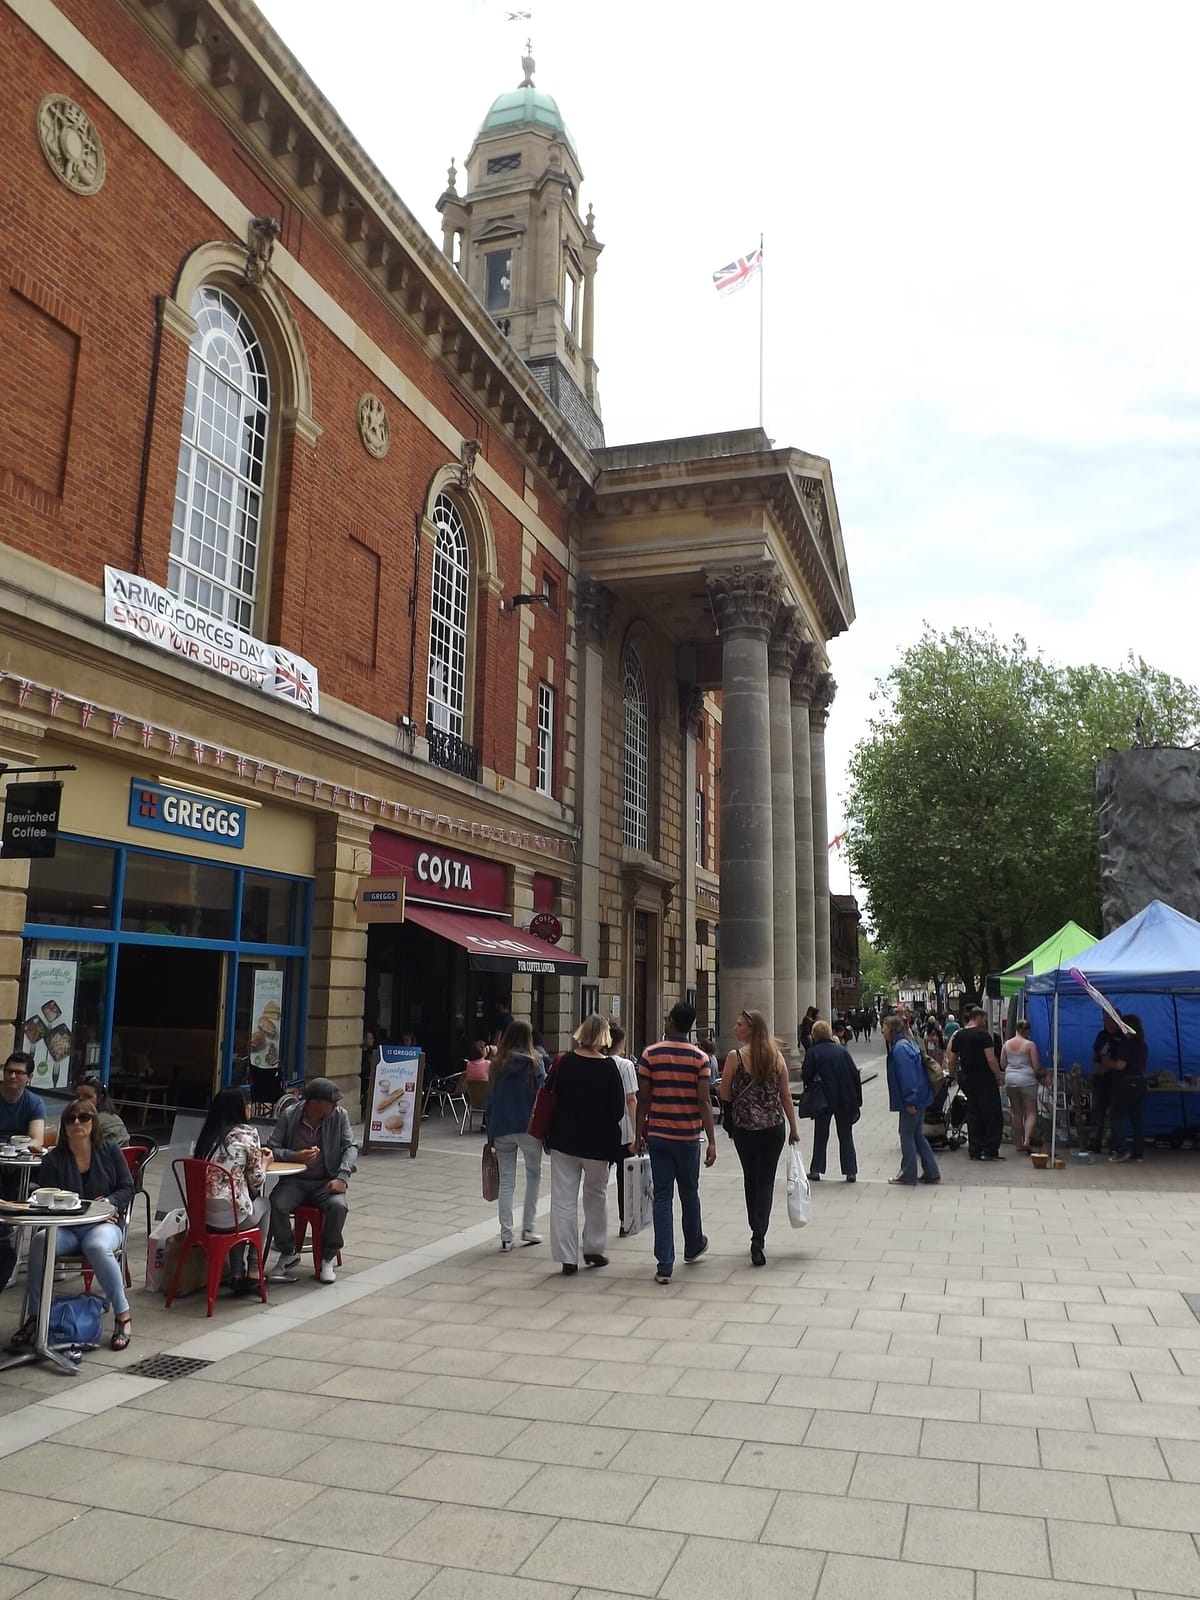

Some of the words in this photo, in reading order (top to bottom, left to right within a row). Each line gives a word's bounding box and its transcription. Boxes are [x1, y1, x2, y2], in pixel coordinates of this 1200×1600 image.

[113, 577, 174, 619] ARMED
[175, 608, 234, 650] FORCES
[239, 638, 265, 663] DAY
[113, 604, 166, 640] SHOW
[168, 627, 200, 661] YOUR
[203, 648, 268, 690] SUPPORT
[6, 810, 57, 823] Bewiched
[163, 795, 240, 837] GREGGS
[12, 827, 47, 838] Coffee
[417, 852, 472, 890] COSTA
[371, 892, 396, 900] GREGGS
[392, 1049, 417, 1057] GREGGS
